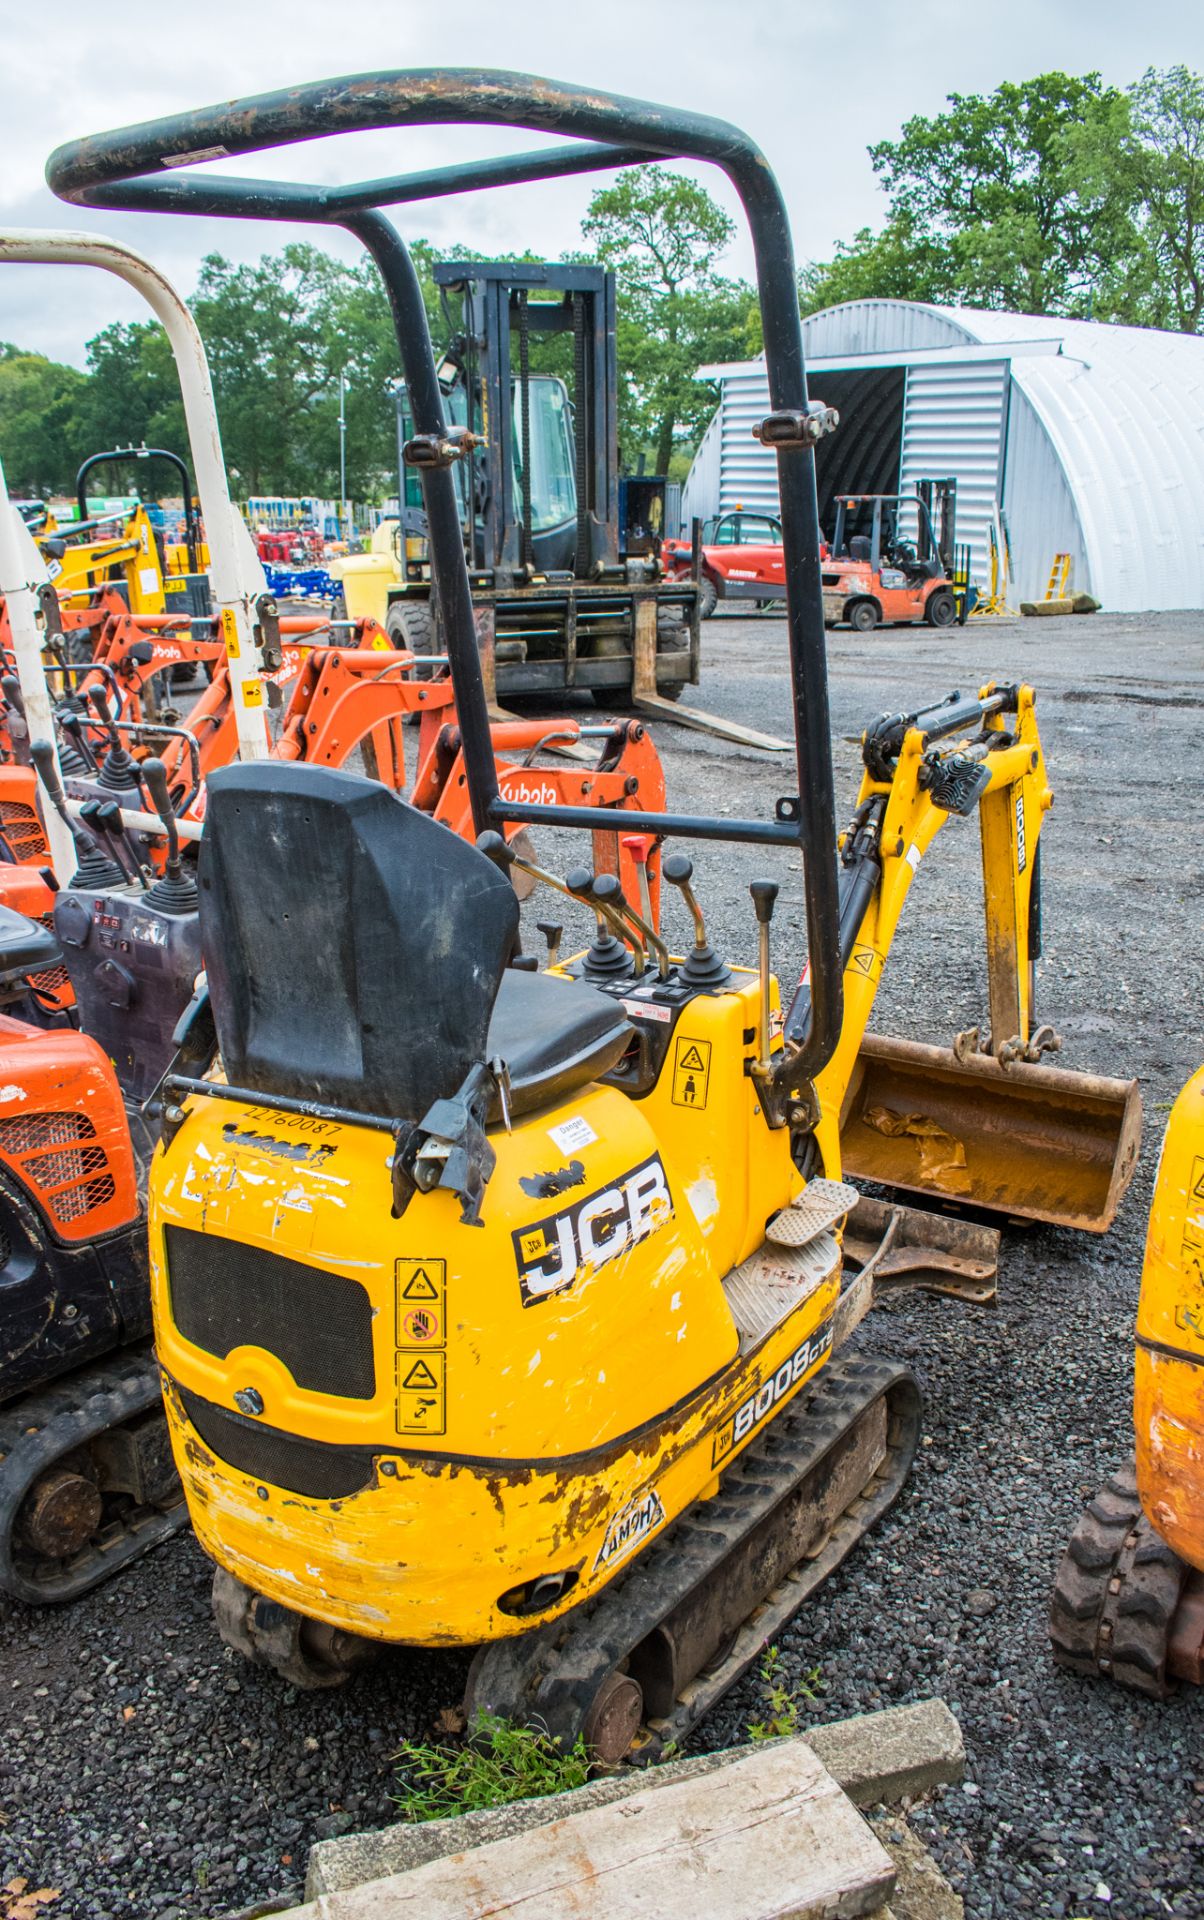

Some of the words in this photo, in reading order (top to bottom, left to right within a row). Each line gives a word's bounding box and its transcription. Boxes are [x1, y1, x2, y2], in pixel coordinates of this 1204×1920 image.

[498, 782, 557, 805] Kubota
[242, 1107, 342, 1136] 22760087
[559, 1118, 583, 1135] Danger
[526, 1161, 671, 1294] JCB
[527, 1239, 542, 1253] JCB
